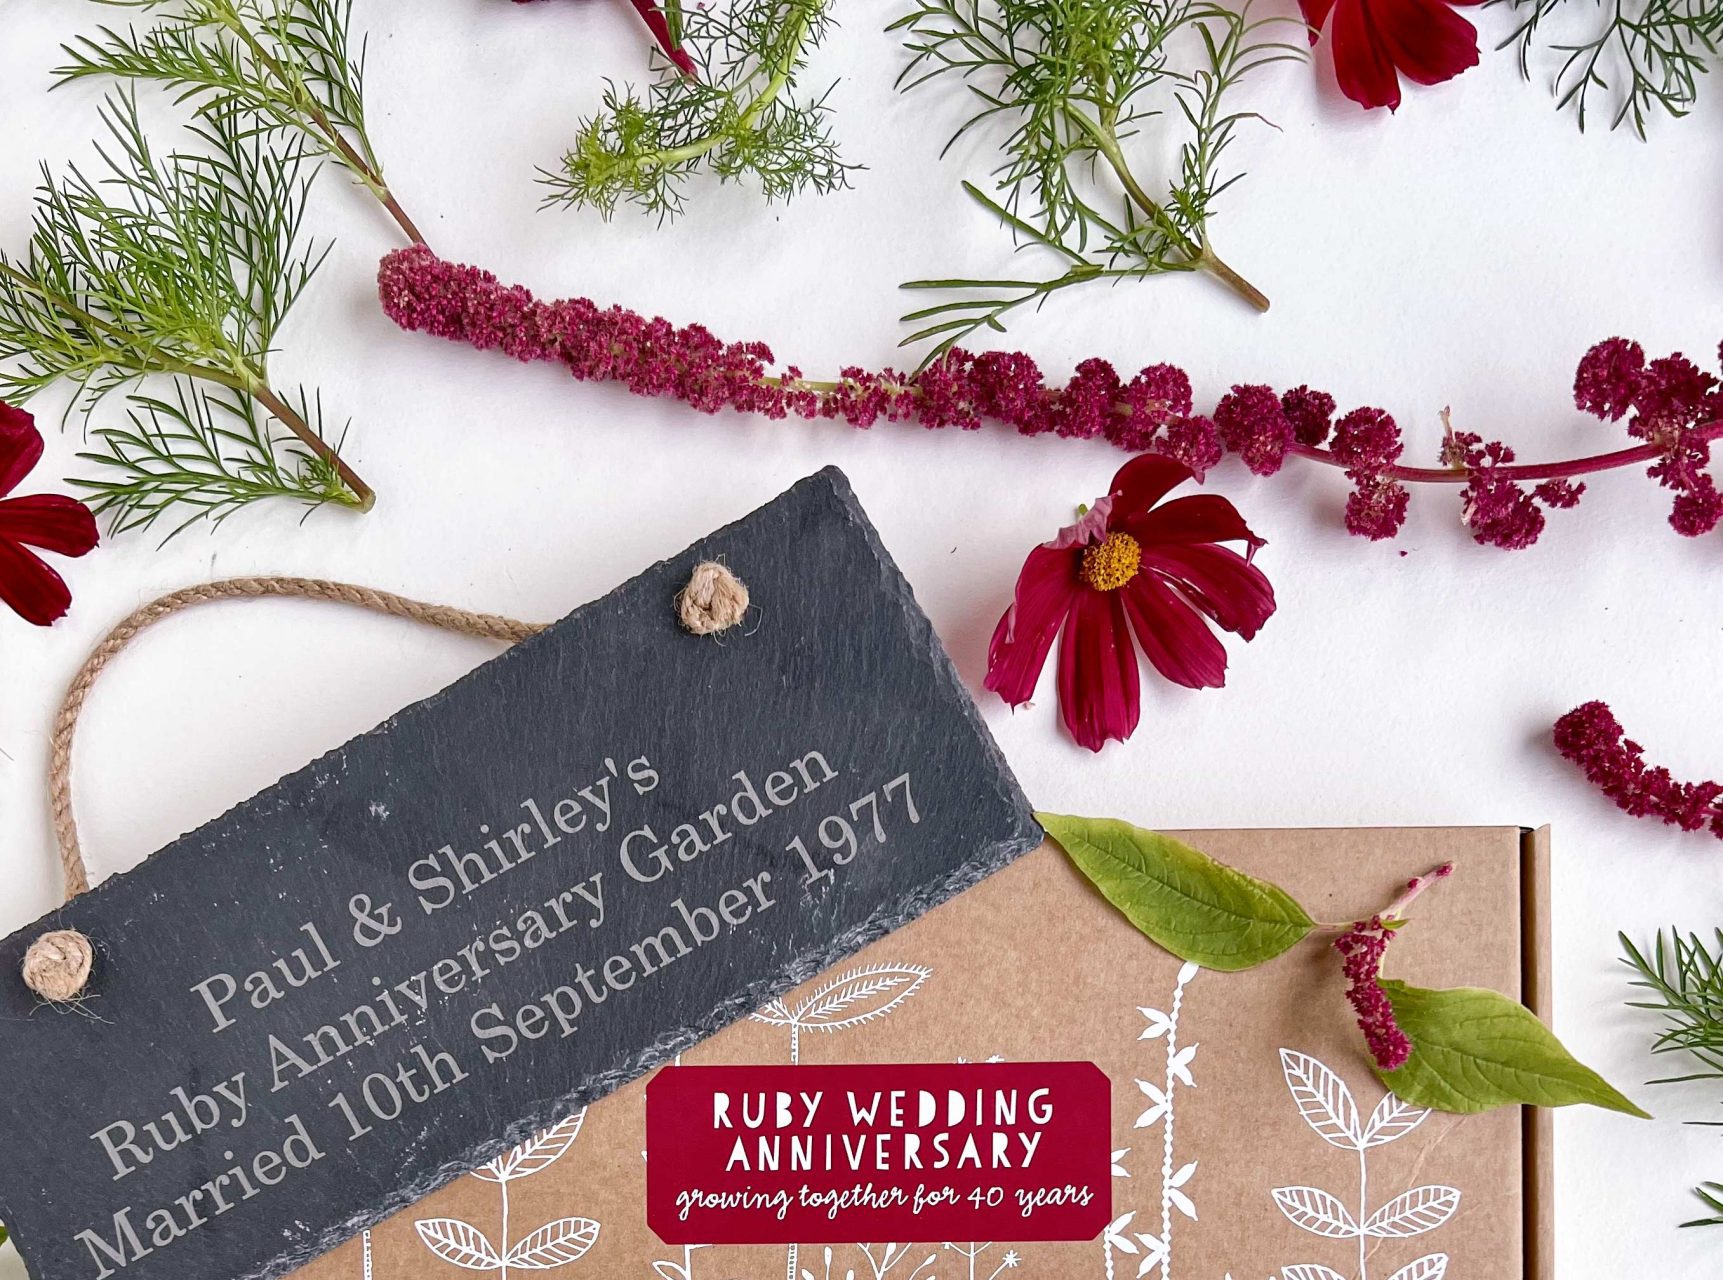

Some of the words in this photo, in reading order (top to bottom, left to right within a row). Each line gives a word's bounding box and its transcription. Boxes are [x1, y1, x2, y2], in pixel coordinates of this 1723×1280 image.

[90, 1072, 250, 1182] Ruby
[265, 873, 607, 1094] Anniversary
[619, 749, 839, 884] Garden
[190, 922, 342, 1034] Paul
[347, 892, 403, 948] &
[408, 754, 660, 915] Shirley's
[73, 1113, 326, 1280] Married
[328, 1048, 469, 1142] 10th
[470, 870, 777, 1063] September
[786, 773, 920, 886] 1977
[713, 1091, 823, 1129] RUBY
[847, 1088, 1054, 1128] WEDDING
[725, 1131, 1042, 1172] ANNIVERSARY
[676, 1186, 795, 1220] growing
[799, 1183, 908, 1220] together
[913, 1183, 960, 1215] for
[967, 1186, 1004, 1210] 40
[1015, 1185, 1094, 1217] years
